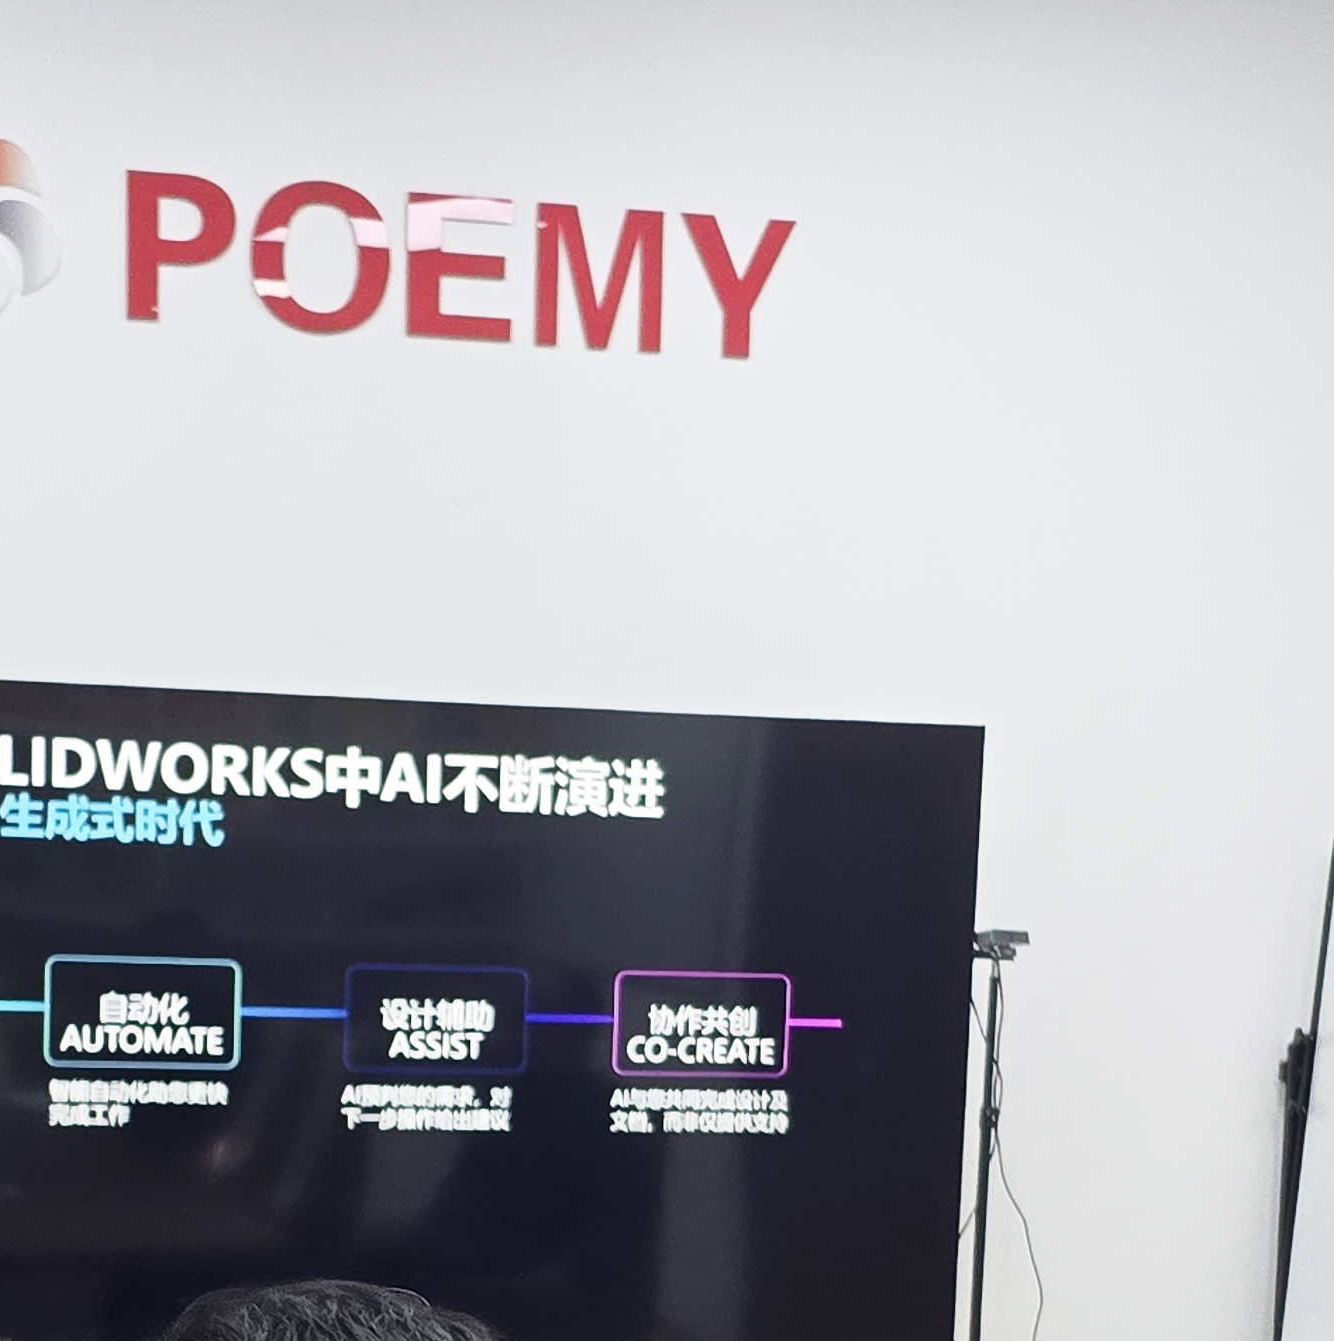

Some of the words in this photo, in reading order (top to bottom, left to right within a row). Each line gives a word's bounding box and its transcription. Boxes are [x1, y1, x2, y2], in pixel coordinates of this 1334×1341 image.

[124, 169, 797, 360] POEMY
[99, 990, 190, 1026] 自动化
[379, 998, 495, 1032] 设计辅助
[647, 1003, 758, 1037] 协作共创
[59, 1023, 224, 1056] AUTOMATE
[388, 1030, 485, 1060] ASSIST
[626, 1035, 775, 1065] CO-CREATE
